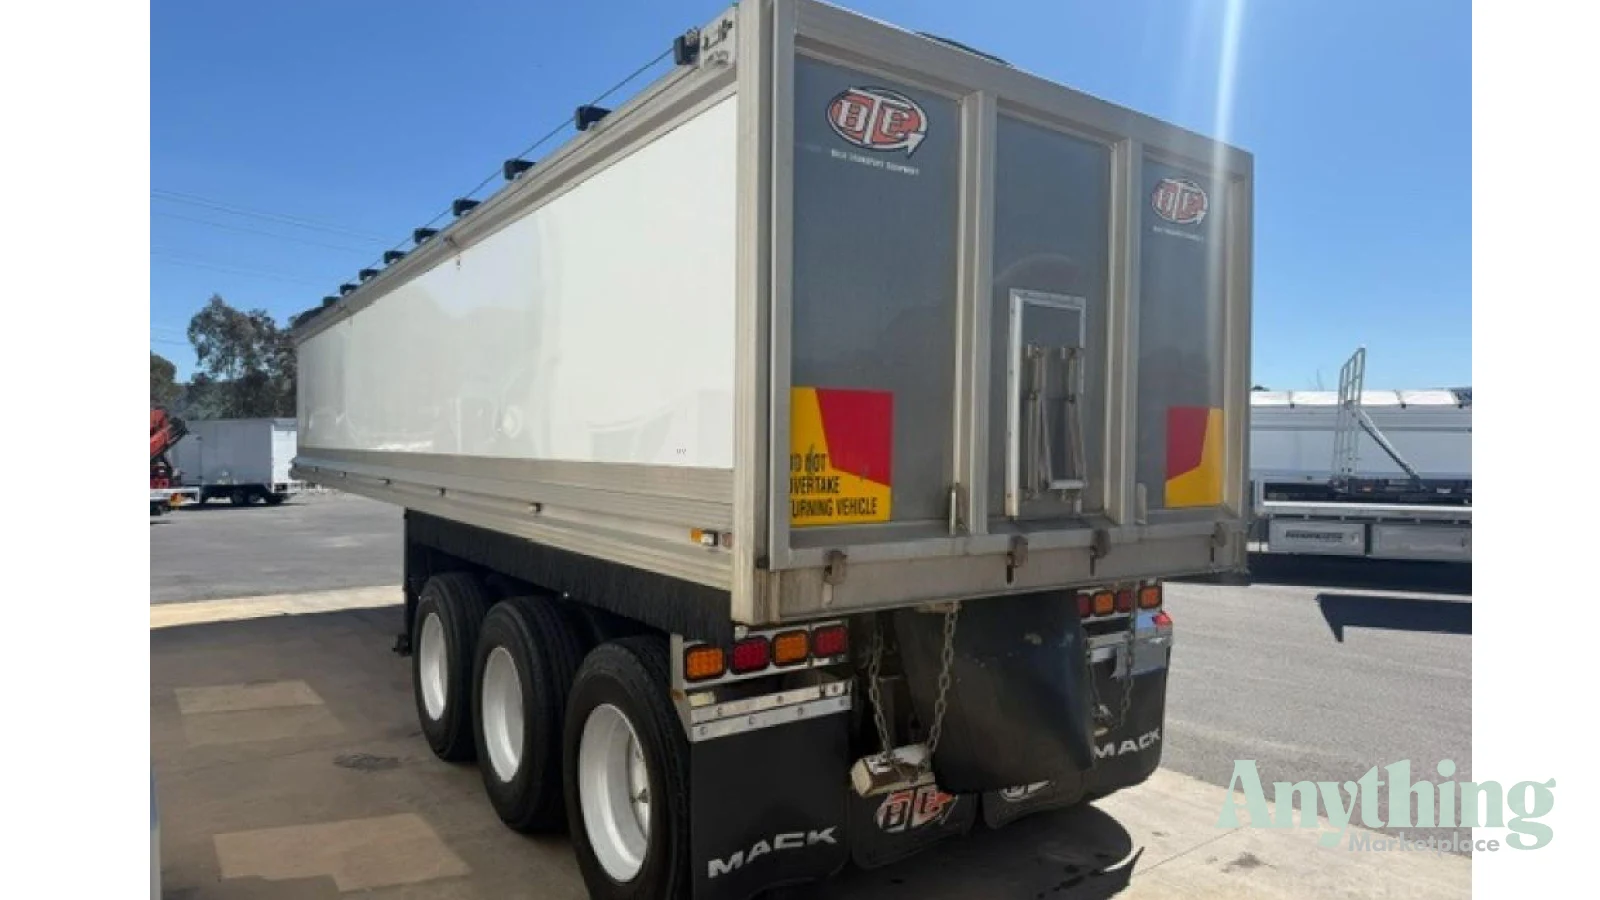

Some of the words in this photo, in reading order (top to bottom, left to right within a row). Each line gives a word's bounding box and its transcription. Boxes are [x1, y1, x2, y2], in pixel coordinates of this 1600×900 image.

[836, 87, 916, 146] BTE
[805, 453, 826, 472] NOT
[836, 497, 878, 516] VEHICLE
[1093, 727, 1160, 759] MACK
[707, 825, 838, 879] MACK
